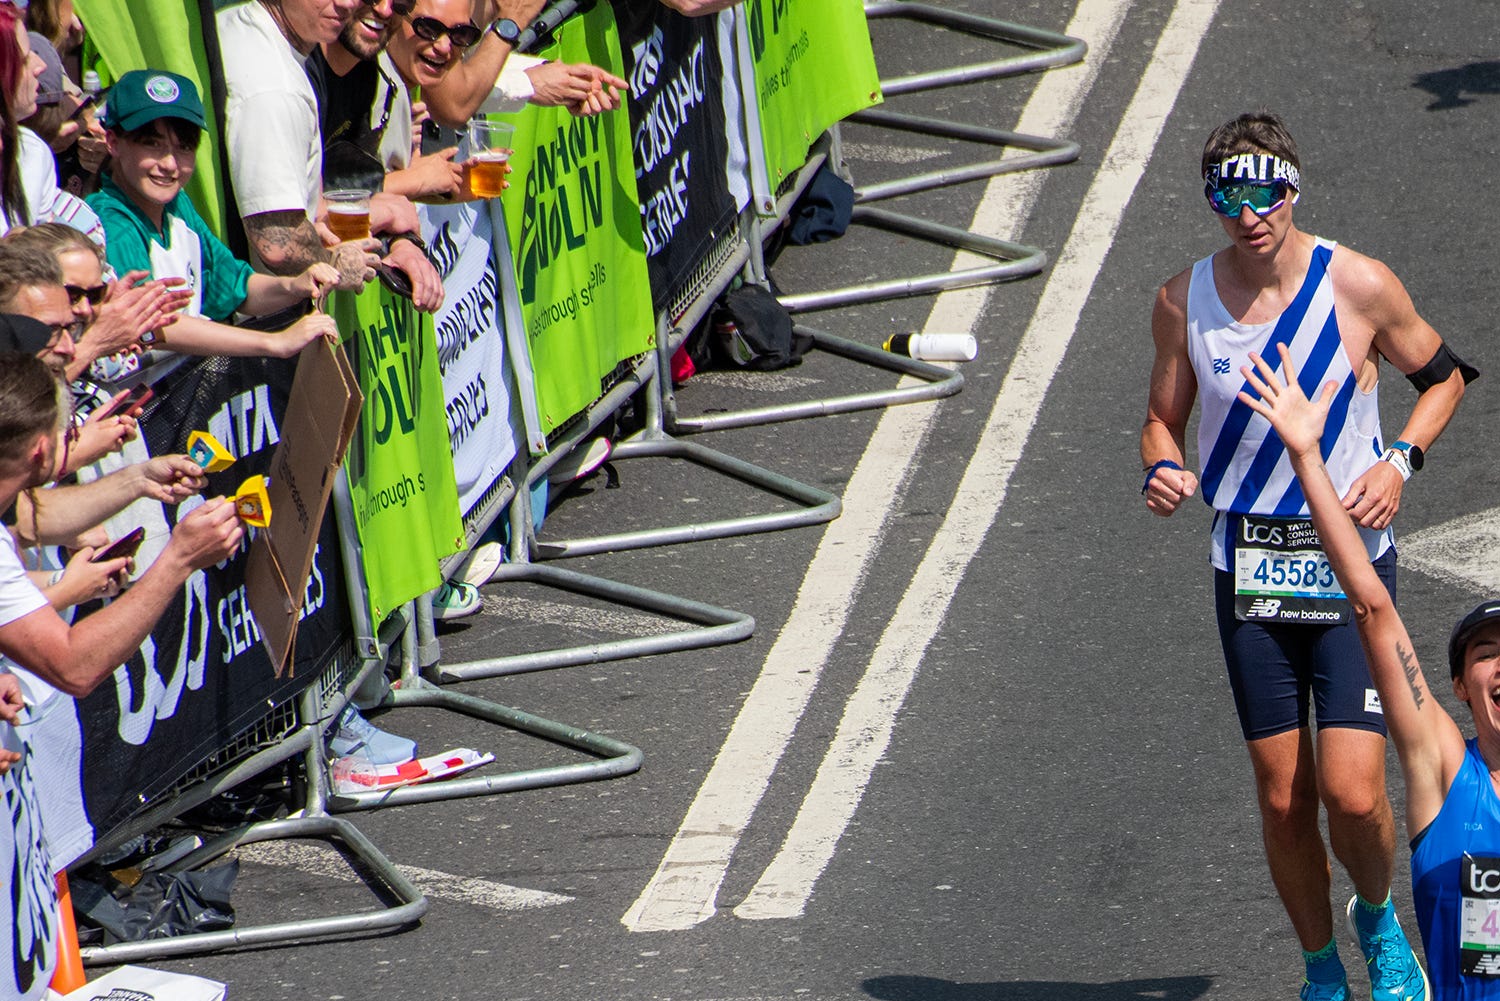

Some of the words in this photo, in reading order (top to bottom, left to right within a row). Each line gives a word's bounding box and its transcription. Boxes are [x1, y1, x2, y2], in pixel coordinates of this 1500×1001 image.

[1244, 518, 1282, 545] tcs
[1287, 523, 1311, 531] TATA
[1287, 537, 1320, 546] SERVICE
[1254, 558, 1334, 588] 45583
[1280, 610, 1300, 618] new
[1301, 610, 1340, 620] balance
